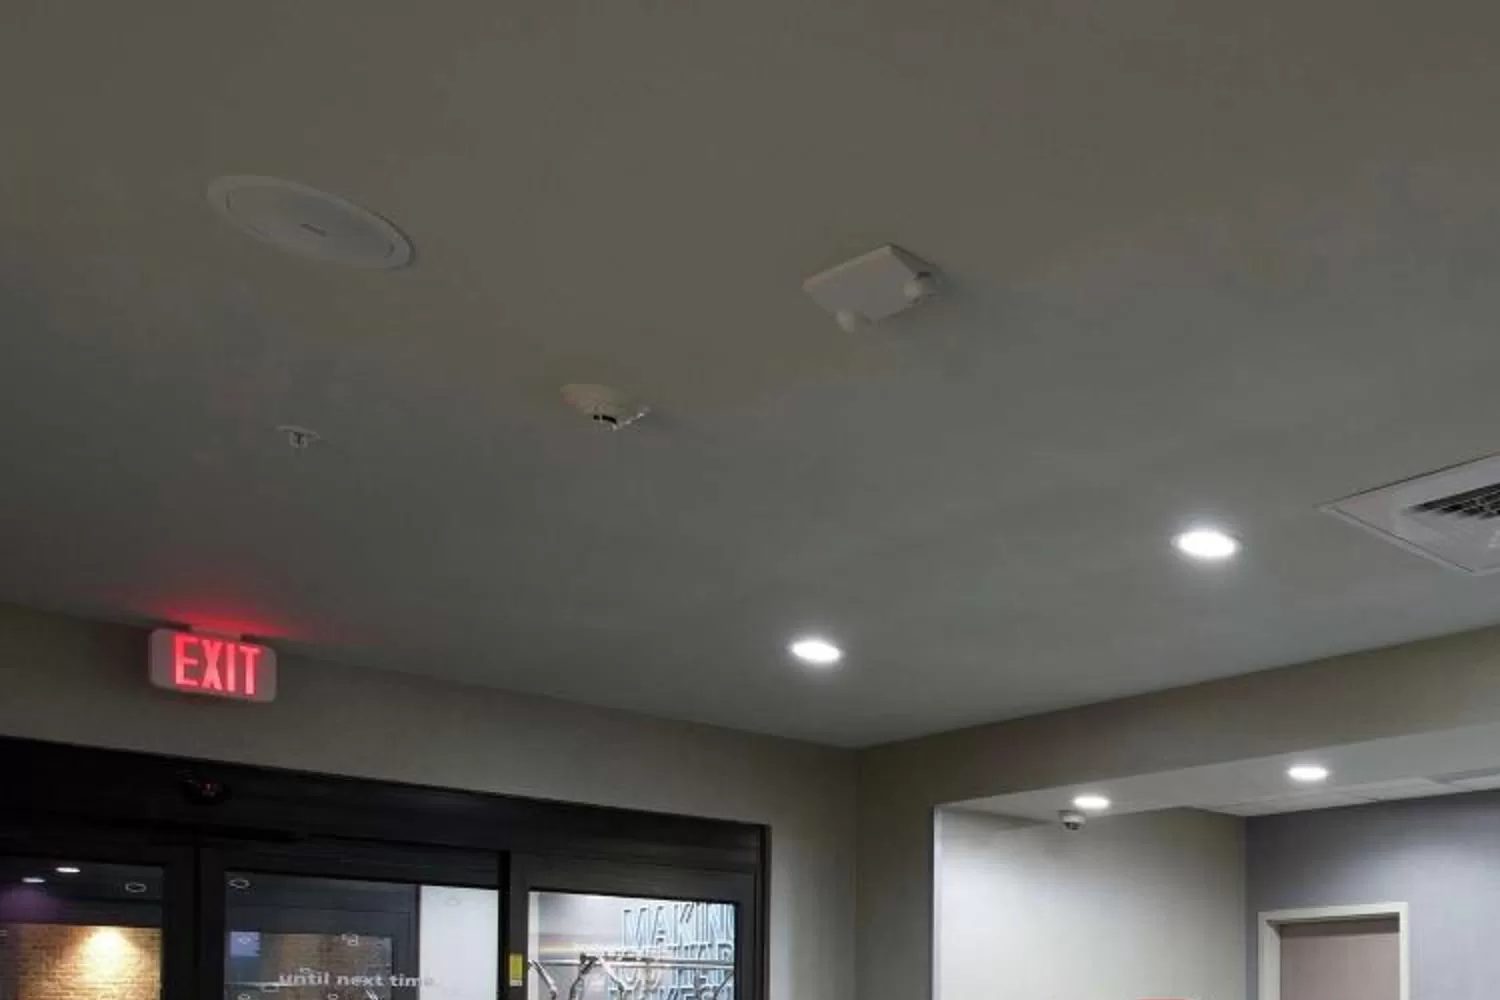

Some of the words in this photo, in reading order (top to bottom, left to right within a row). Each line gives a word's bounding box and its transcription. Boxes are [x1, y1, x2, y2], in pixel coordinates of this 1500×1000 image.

[174, 634, 261, 695] EXIT
[279, 972, 329, 986] until
[336, 975, 384, 987] next
